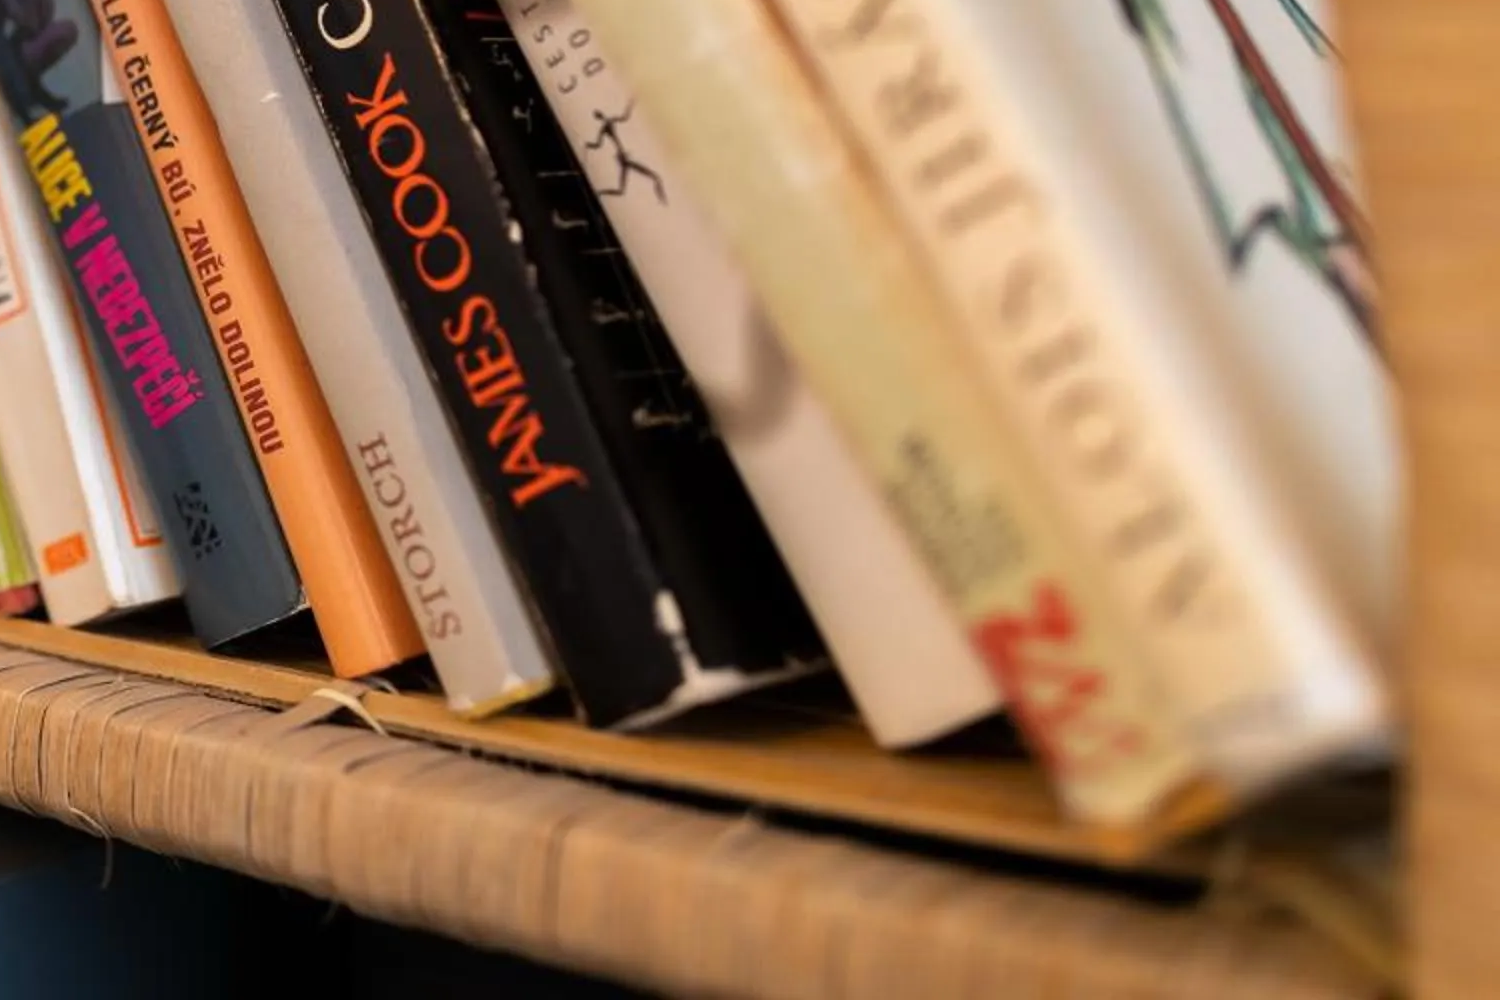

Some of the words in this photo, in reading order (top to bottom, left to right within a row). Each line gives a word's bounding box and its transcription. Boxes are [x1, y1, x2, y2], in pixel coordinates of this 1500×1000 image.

[122, 53, 180, 153] ČERNÝ
[567, 28, 605, 78] DO
[18, 111, 93, 223] ALICE
[61, 201, 108, 250] V
[346, 51, 473, 292] COOK
[73, 232, 205, 430] NEBEZPEČÍ
[182, 218, 233, 316] ZNĚLO
[219, 317, 285, 456] DOLINOU
[442, 294, 588, 509] JAMES
